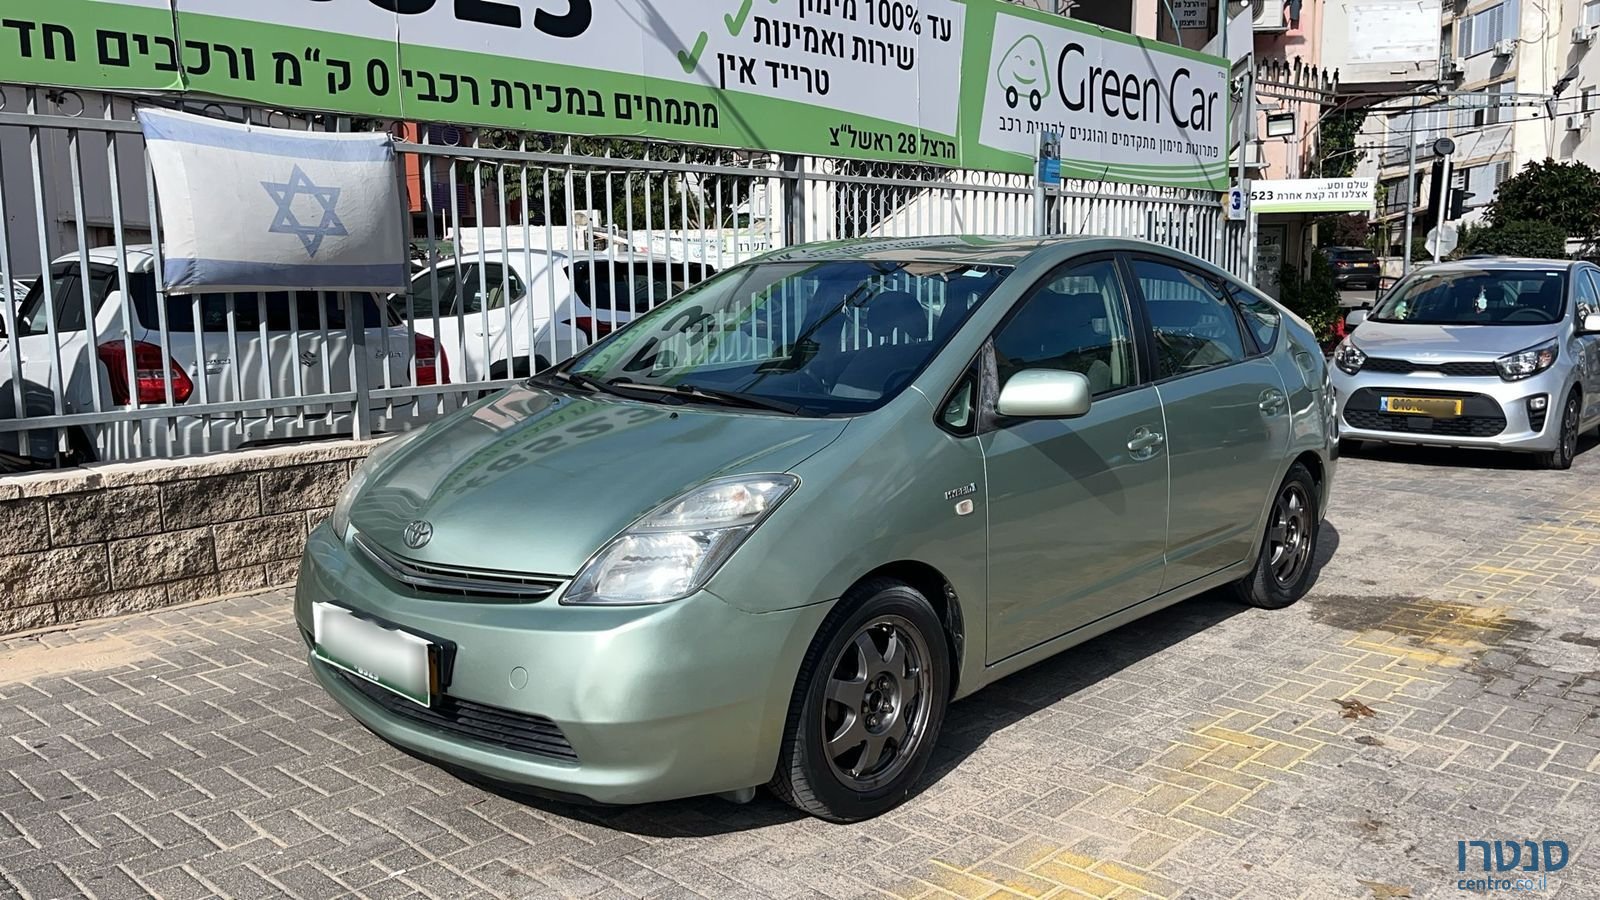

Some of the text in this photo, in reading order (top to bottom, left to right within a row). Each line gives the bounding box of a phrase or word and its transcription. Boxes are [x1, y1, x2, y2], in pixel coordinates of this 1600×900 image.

[865, 0, 921, 35] 100%
[927, 14, 951, 42] עד
[2, 19, 77, 63] חד
[753, 16, 914, 71] שירות ואמינות
[96, 29, 256, 82] ורכבים
[367, 58, 390, 97] 0
[717, 52, 829, 95] טרייד אין
[401, 69, 480, 106] רכבי
[490, 78, 606, 118] במכירת
[1057, 42, 1218, 133] Green Car
[613, 92, 719, 129] מתמחים
[999, 116, 1021, 132] רכב
[1070, 126, 1108, 144] והוגנים
[897, 132, 917, 154] 28
[920, 134, 956, 159] הרצל
[1112, 132, 1156, 152] מתקדמים
[1159, 139, 1183, 154] מימון
[1185, 142, 1219, 158] פתרונות
[1276, 192, 1302, 200] אחרת
[1305, 191, 1325, 200] קצת
[1328, 191, 1339, 199] זה
[1341, 189, 1368, 198] אצלנו
[1346, 181, 1369, 189] שלם
